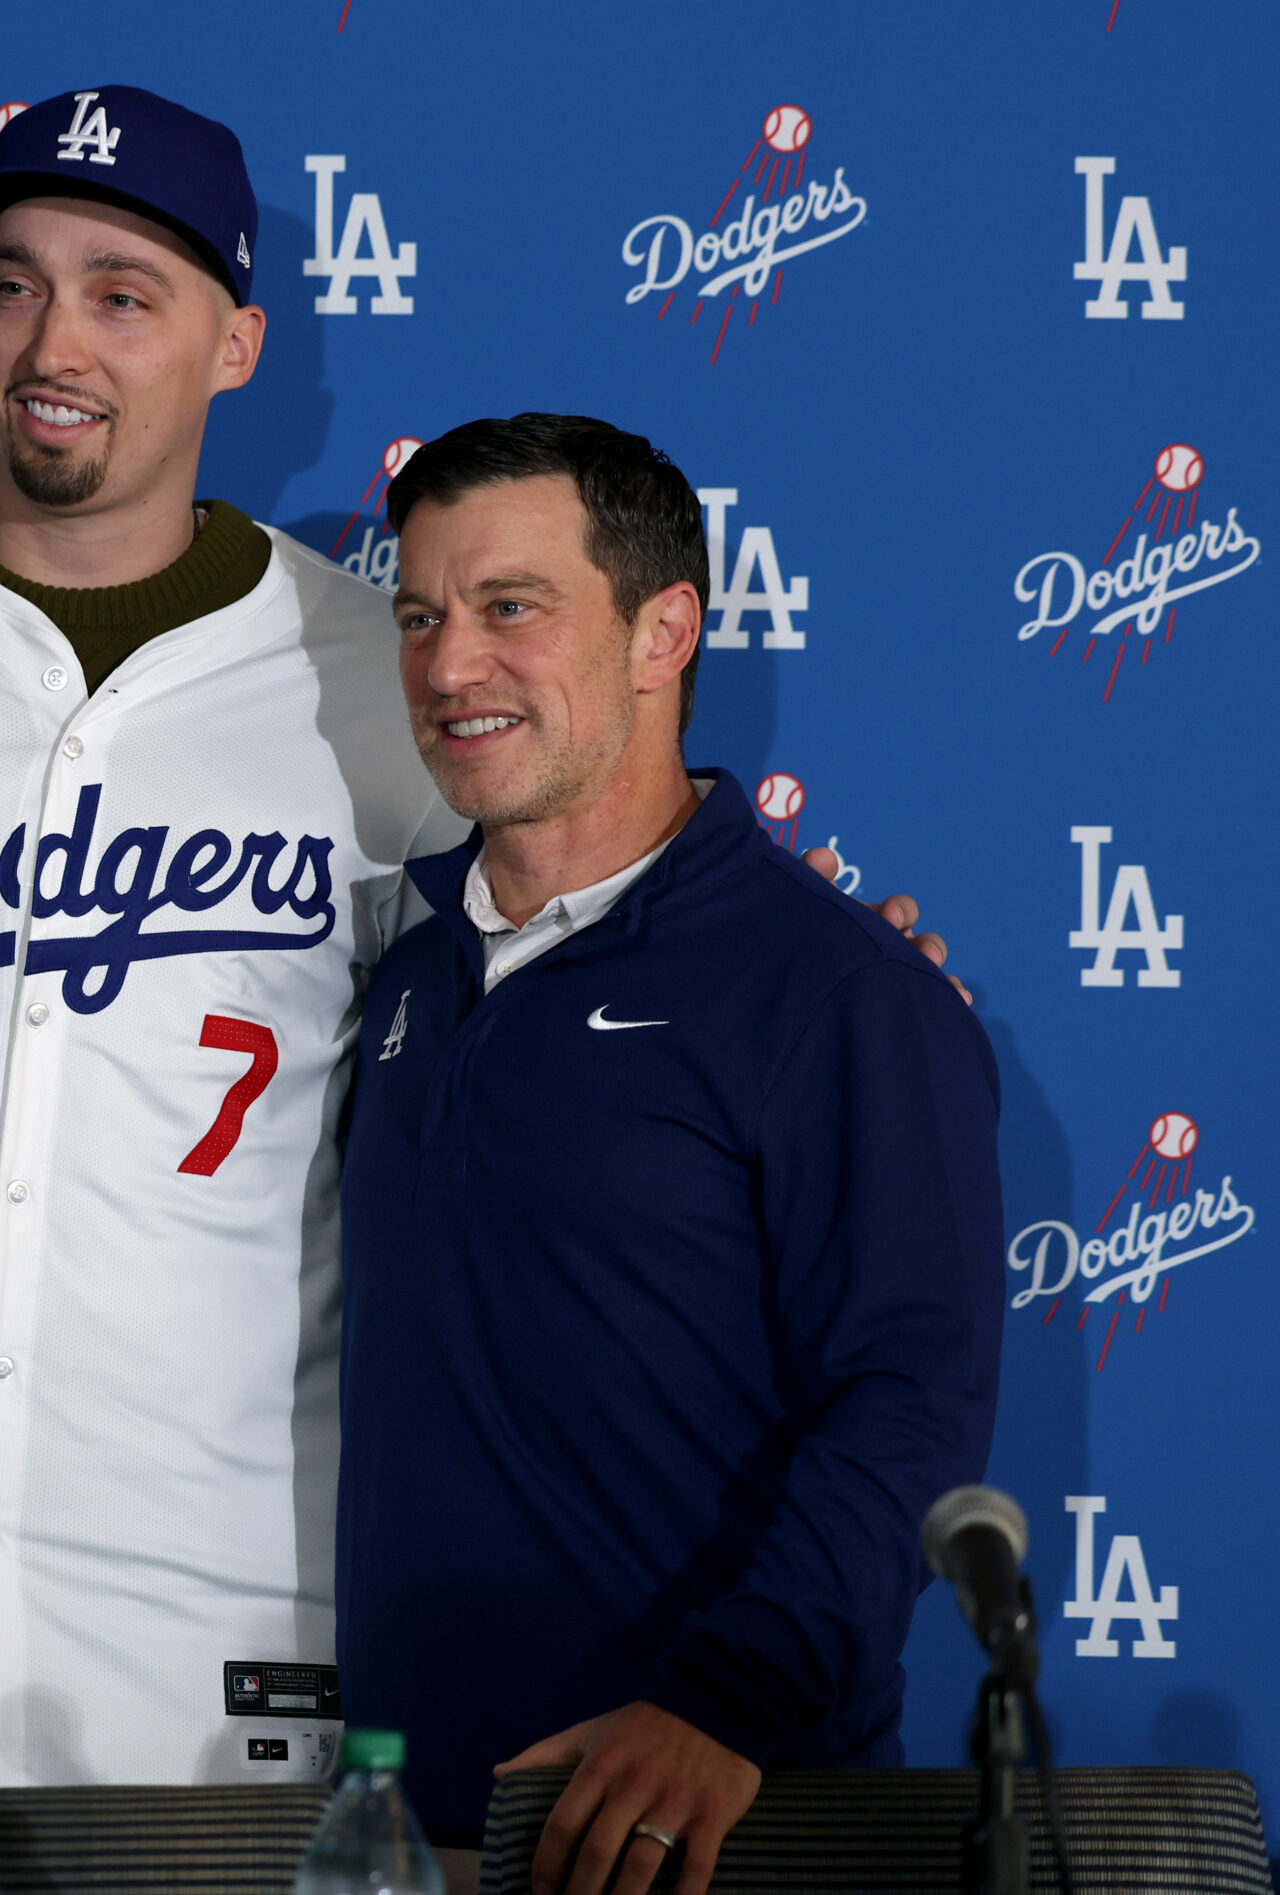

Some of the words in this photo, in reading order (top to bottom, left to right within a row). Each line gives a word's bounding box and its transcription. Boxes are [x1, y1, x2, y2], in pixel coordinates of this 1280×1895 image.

[58, 93, 121, 165] LA
[304, 155, 416, 314] LA
[622, 168, 866, 304] Dodgers
[1074, 157, 1186, 319] LA
[697, 488, 809, 649] LA
[1015, 508, 1259, 636] Dodgers
[1070, 826, 1183, 987] LA
[177, 1014, 278, 1177] 7
[1008, 1176, 1254, 1308] Dodgers
[1064, 1496, 1178, 1658] LA
